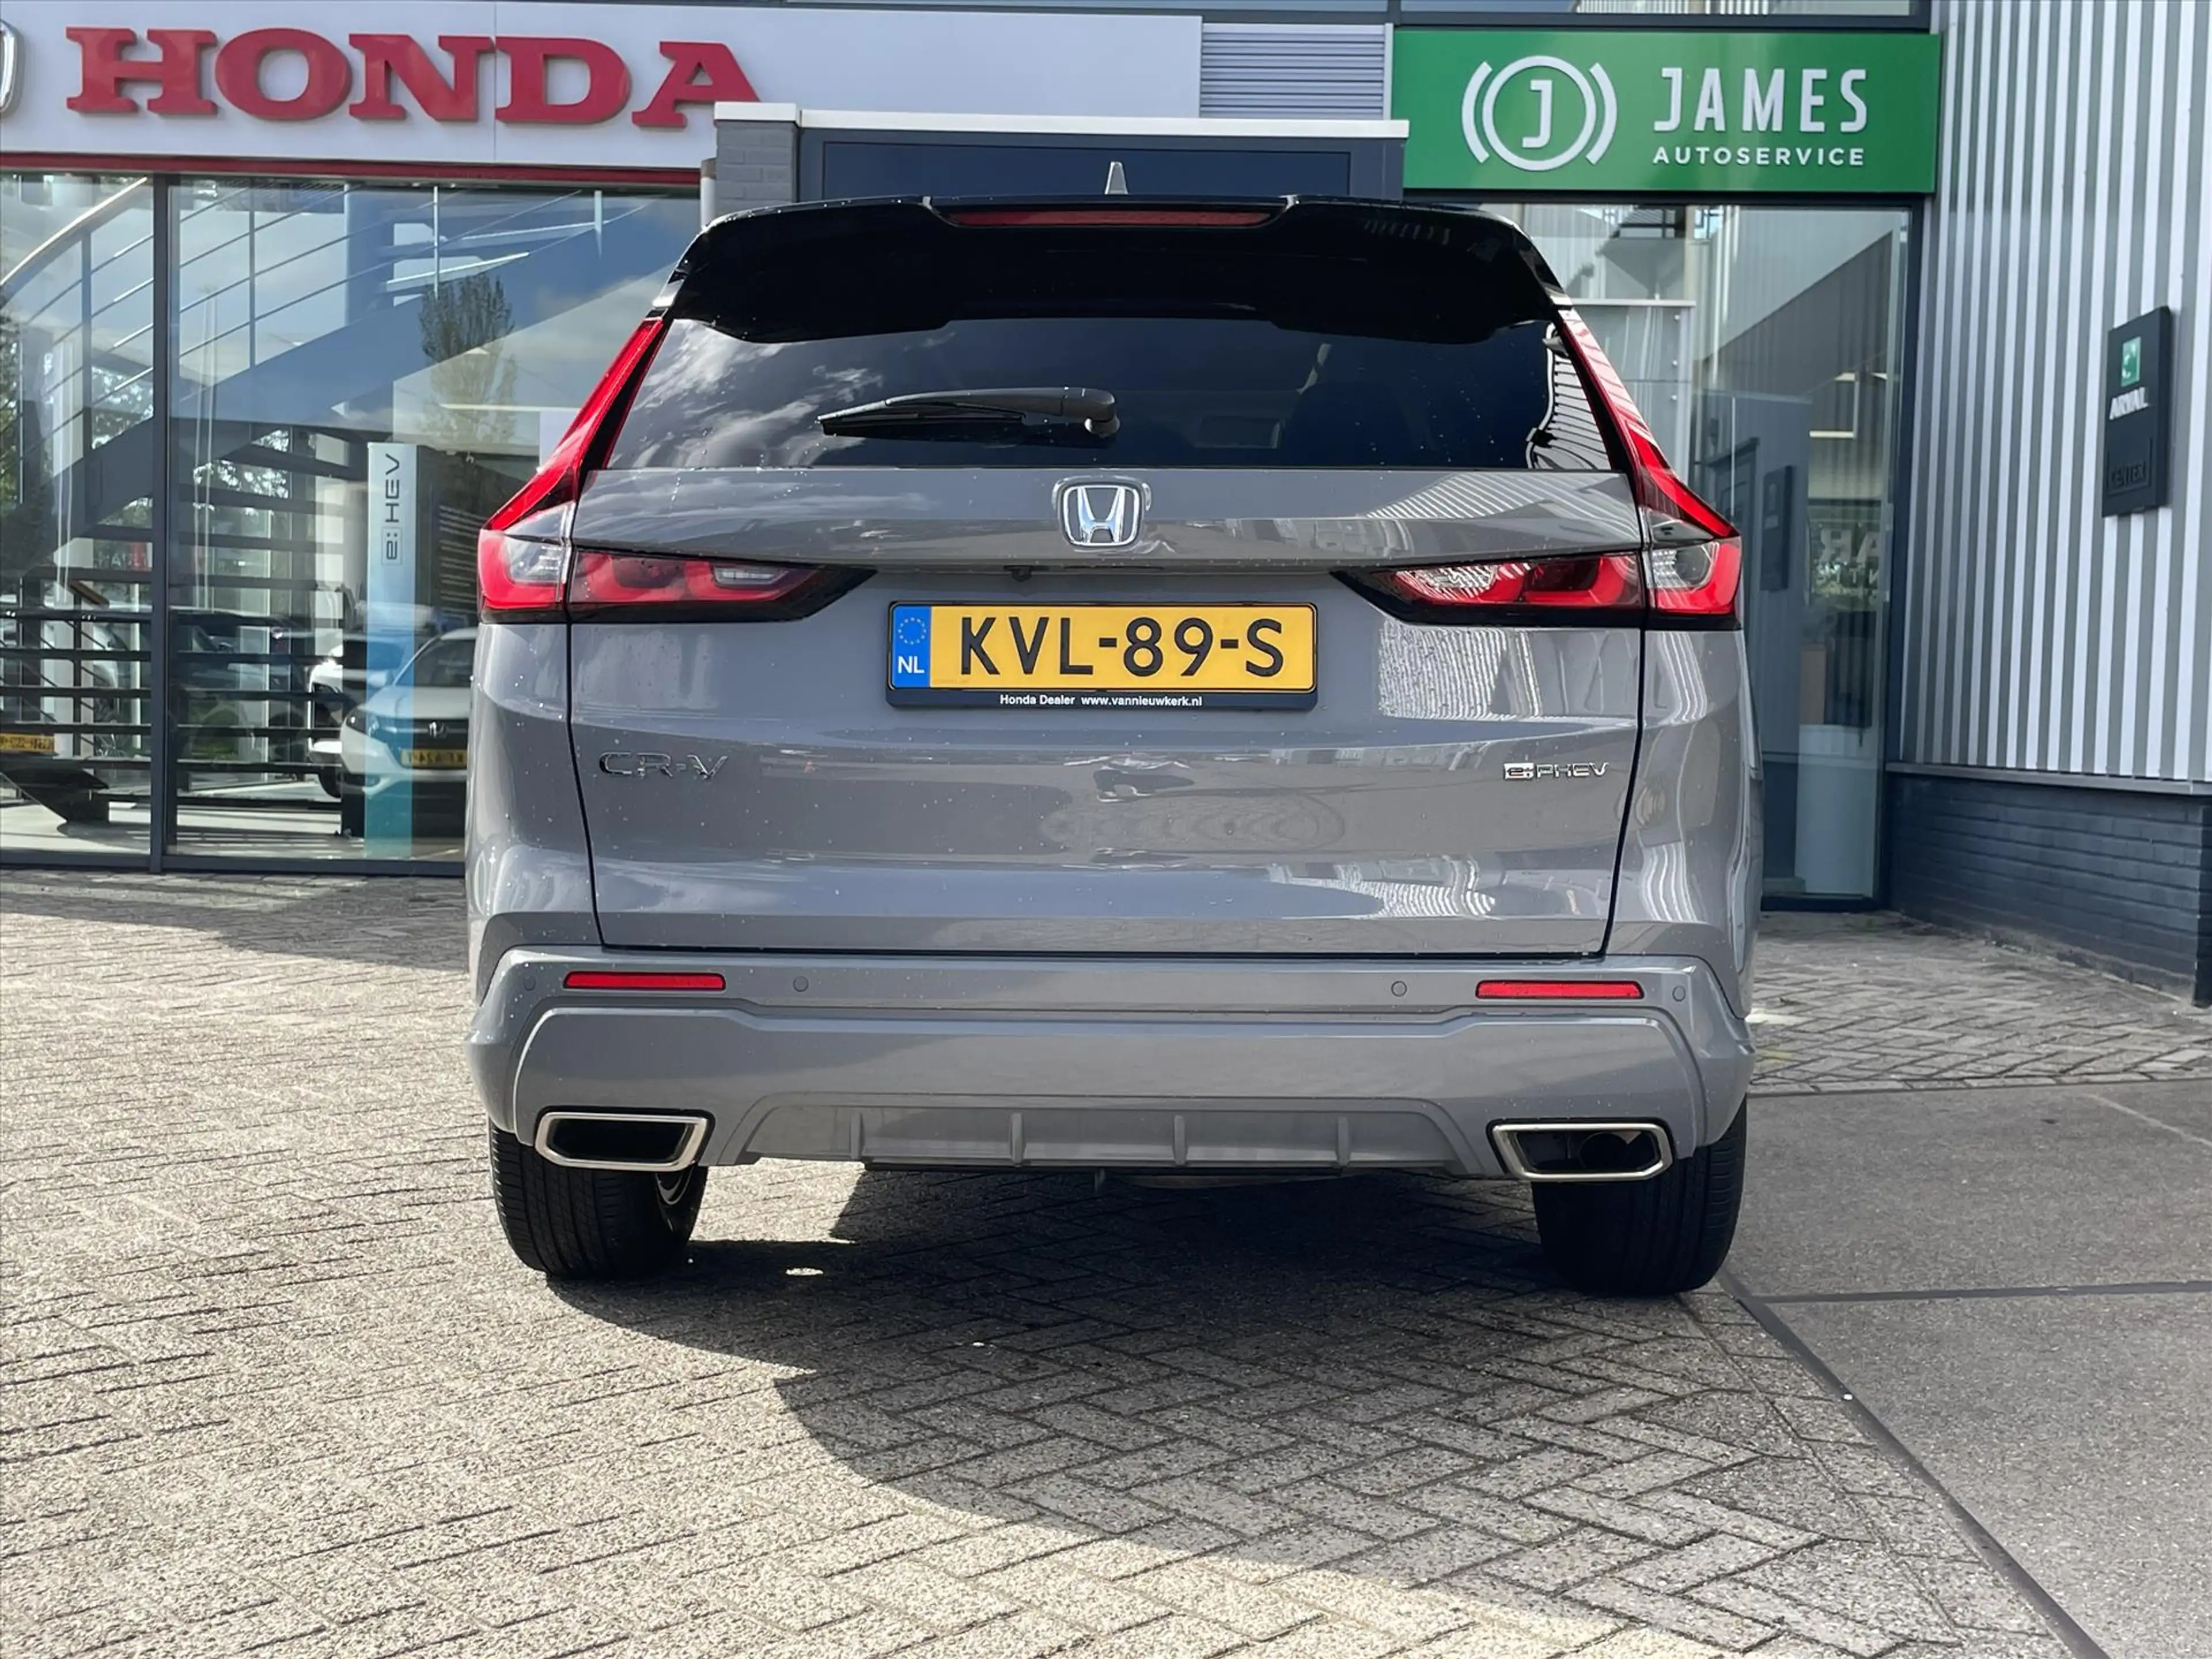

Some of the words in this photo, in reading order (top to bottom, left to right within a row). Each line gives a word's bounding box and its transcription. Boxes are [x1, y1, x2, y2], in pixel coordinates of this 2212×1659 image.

[66, 26, 760, 127] HONDA
[1653, 67, 1868, 133] JAMES
[1652, 146, 1865, 167] AUTOSERVICE
[960, 616, 1285, 677] KVL-89-S
[898, 655, 925, 674] NL
[1000, 694, 1037, 706] Honda
[1039, 694, 1075, 706] Dealer
[1081, 696, 1203, 707] www.vannieuwkerk.nl
[599, 751, 729, 779] CR-V
